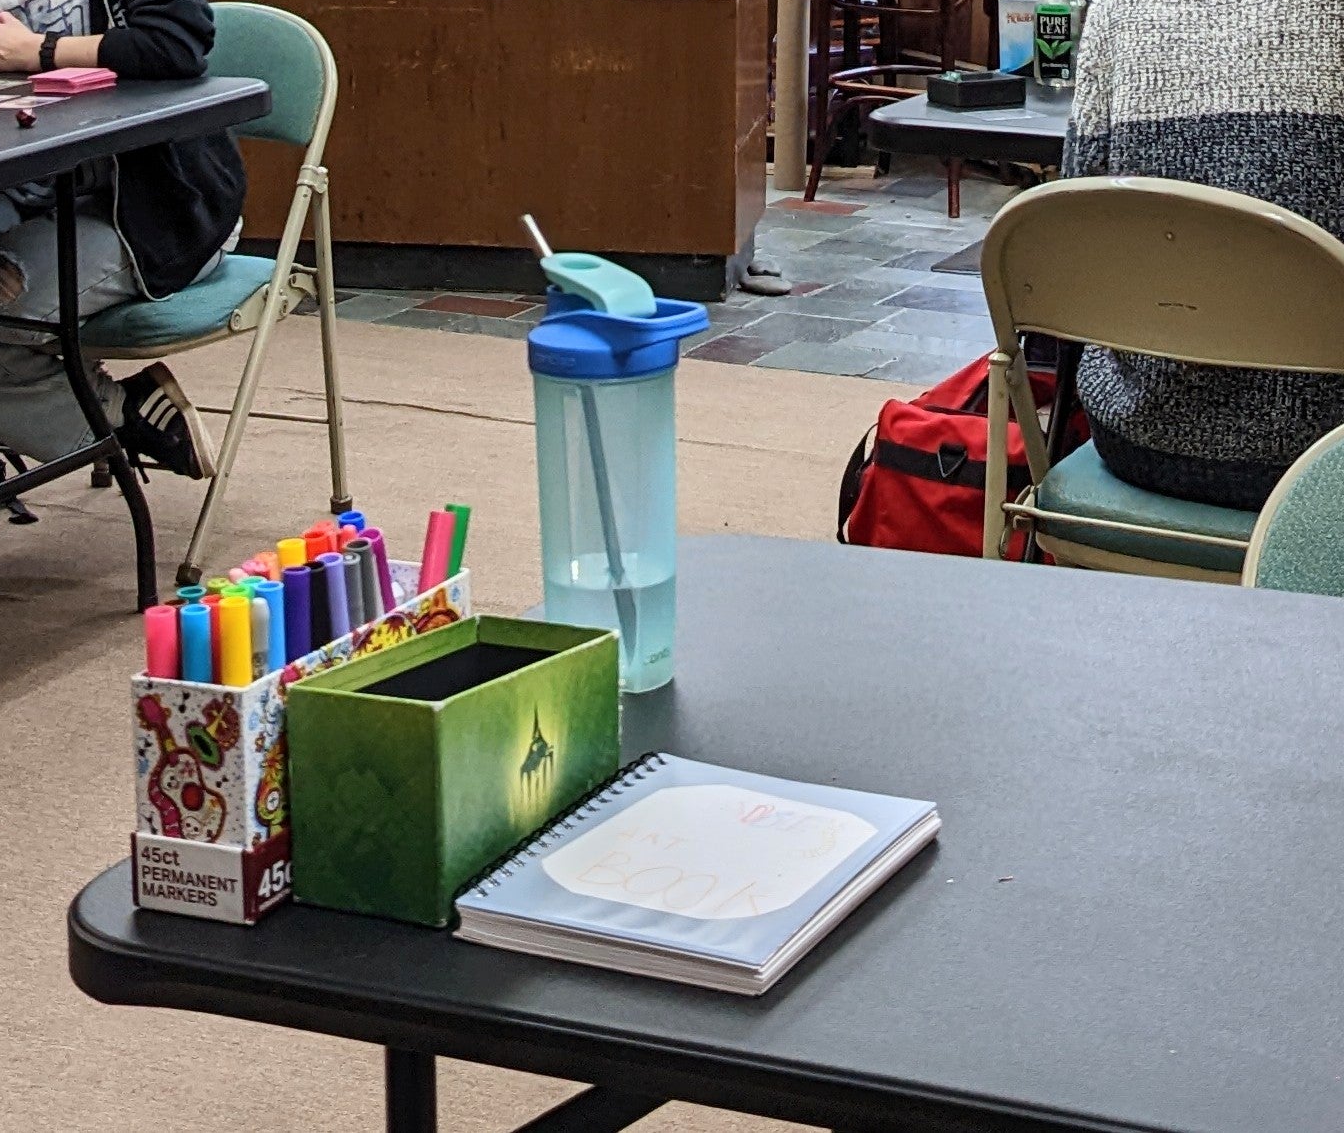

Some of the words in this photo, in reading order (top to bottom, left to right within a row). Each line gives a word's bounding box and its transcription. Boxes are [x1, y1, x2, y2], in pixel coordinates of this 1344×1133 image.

[1039, 16, 1068, 27] PURE
[1039, 25, 1068, 36] LEAF
[141, 845, 181, 867] 45ct
[141, 864, 239, 894] PERMANENT
[576, 850, 779, 915] BOOK
[141, 881, 218, 907] MARKERS
